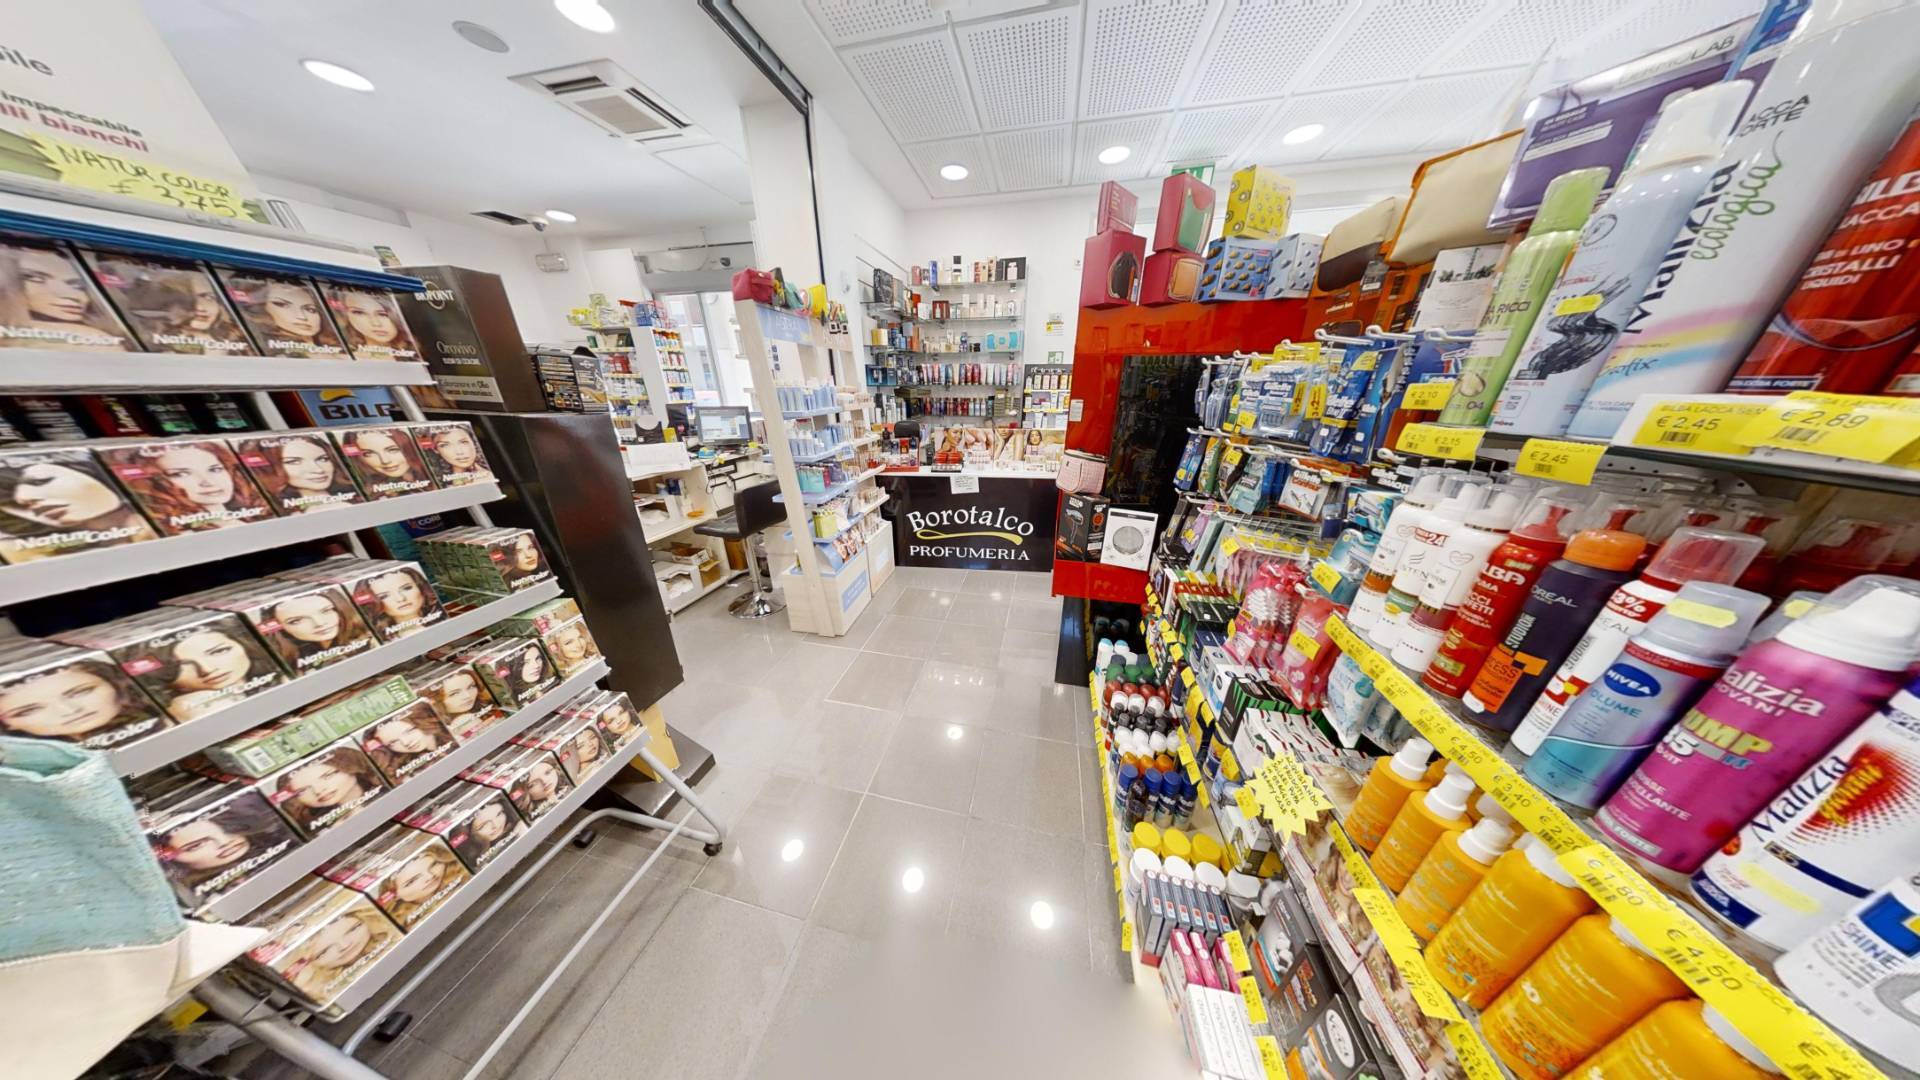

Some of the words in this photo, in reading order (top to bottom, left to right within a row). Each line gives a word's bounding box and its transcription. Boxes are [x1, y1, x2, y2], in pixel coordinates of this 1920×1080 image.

[0, 45, 54, 77] ile
[40, 114, 149, 152] bianchi
[906, 506, 1034, 536] Borotalco
[909, 545, 1031, 561] PROFUMERIA
[1606, 669, 1651, 695] NIVEA
[1590, 689, 1643, 719] OLUME
